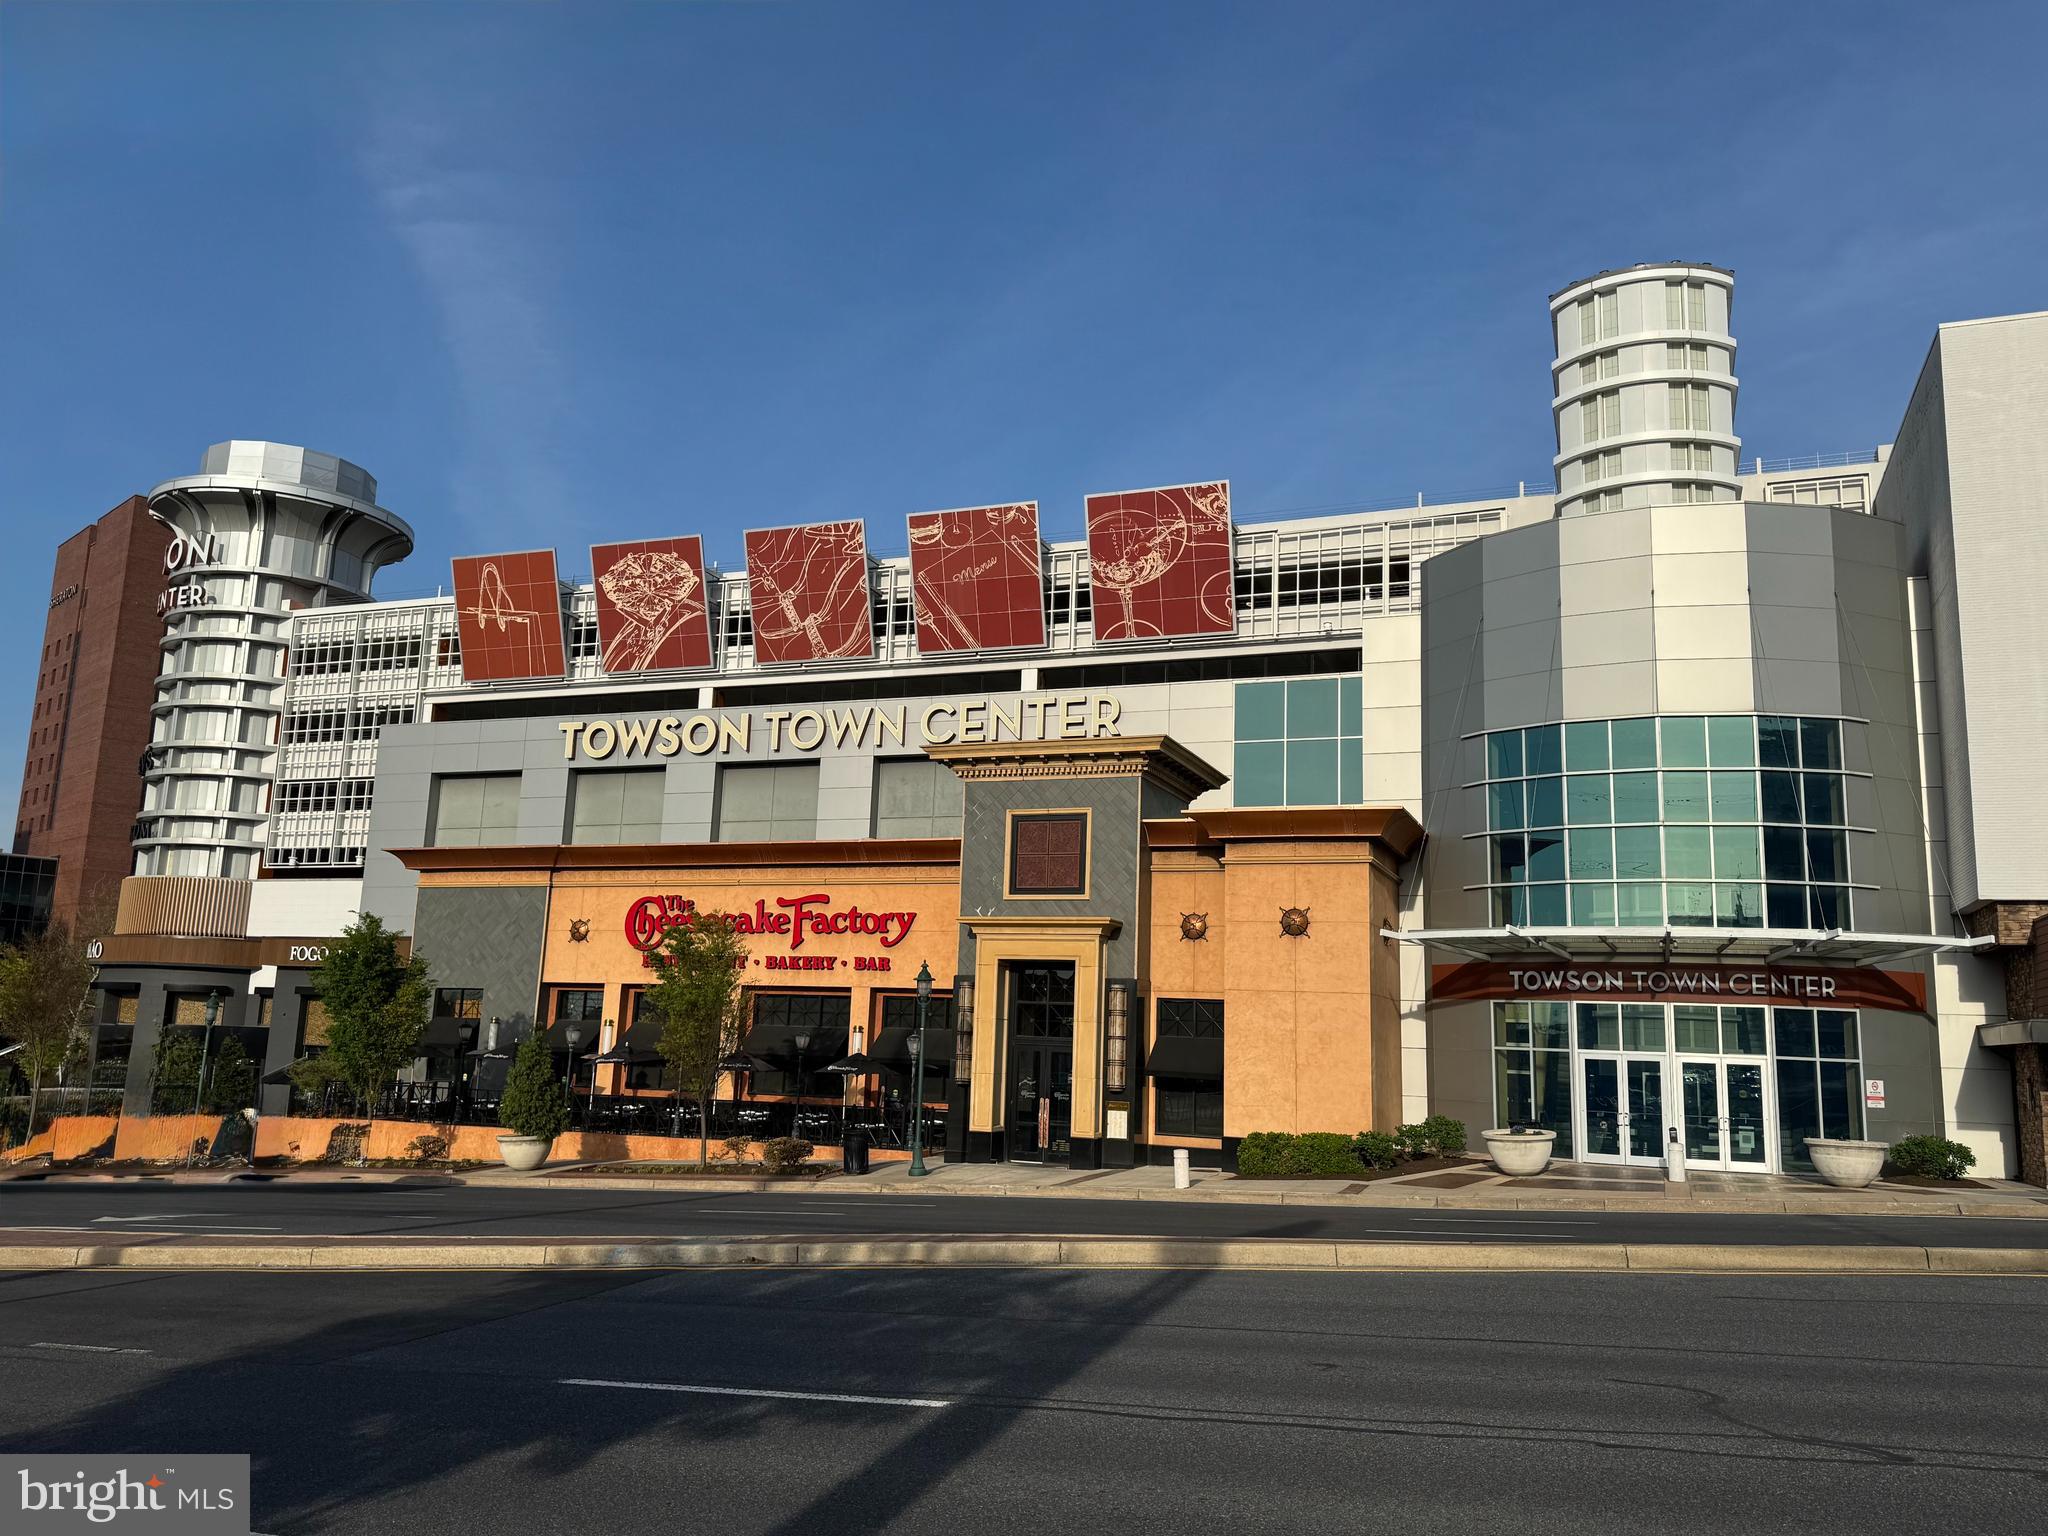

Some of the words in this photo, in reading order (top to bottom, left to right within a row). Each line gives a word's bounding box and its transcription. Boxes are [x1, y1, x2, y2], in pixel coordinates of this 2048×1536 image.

[162, 533, 214, 575] ON
[953, 556, 998, 585] Menu
[157, 585, 205, 614] NTER
[559, 713, 752, 761] TOWSON
[763, 705, 907, 751] TOWN
[920, 693, 1121, 743] CENTER
[665, 895, 696, 913] The
[776, 894, 917, 950] Factory
[289, 946, 330, 961] FOGO
[765, 955, 837, 970] BAKERY
[854, 956, 892, 971] BAR
[1509, 970, 1623, 991] TOWSON
[1631, 971, 1721, 993] TOWN
[1729, 973, 1836, 998] CENTER
